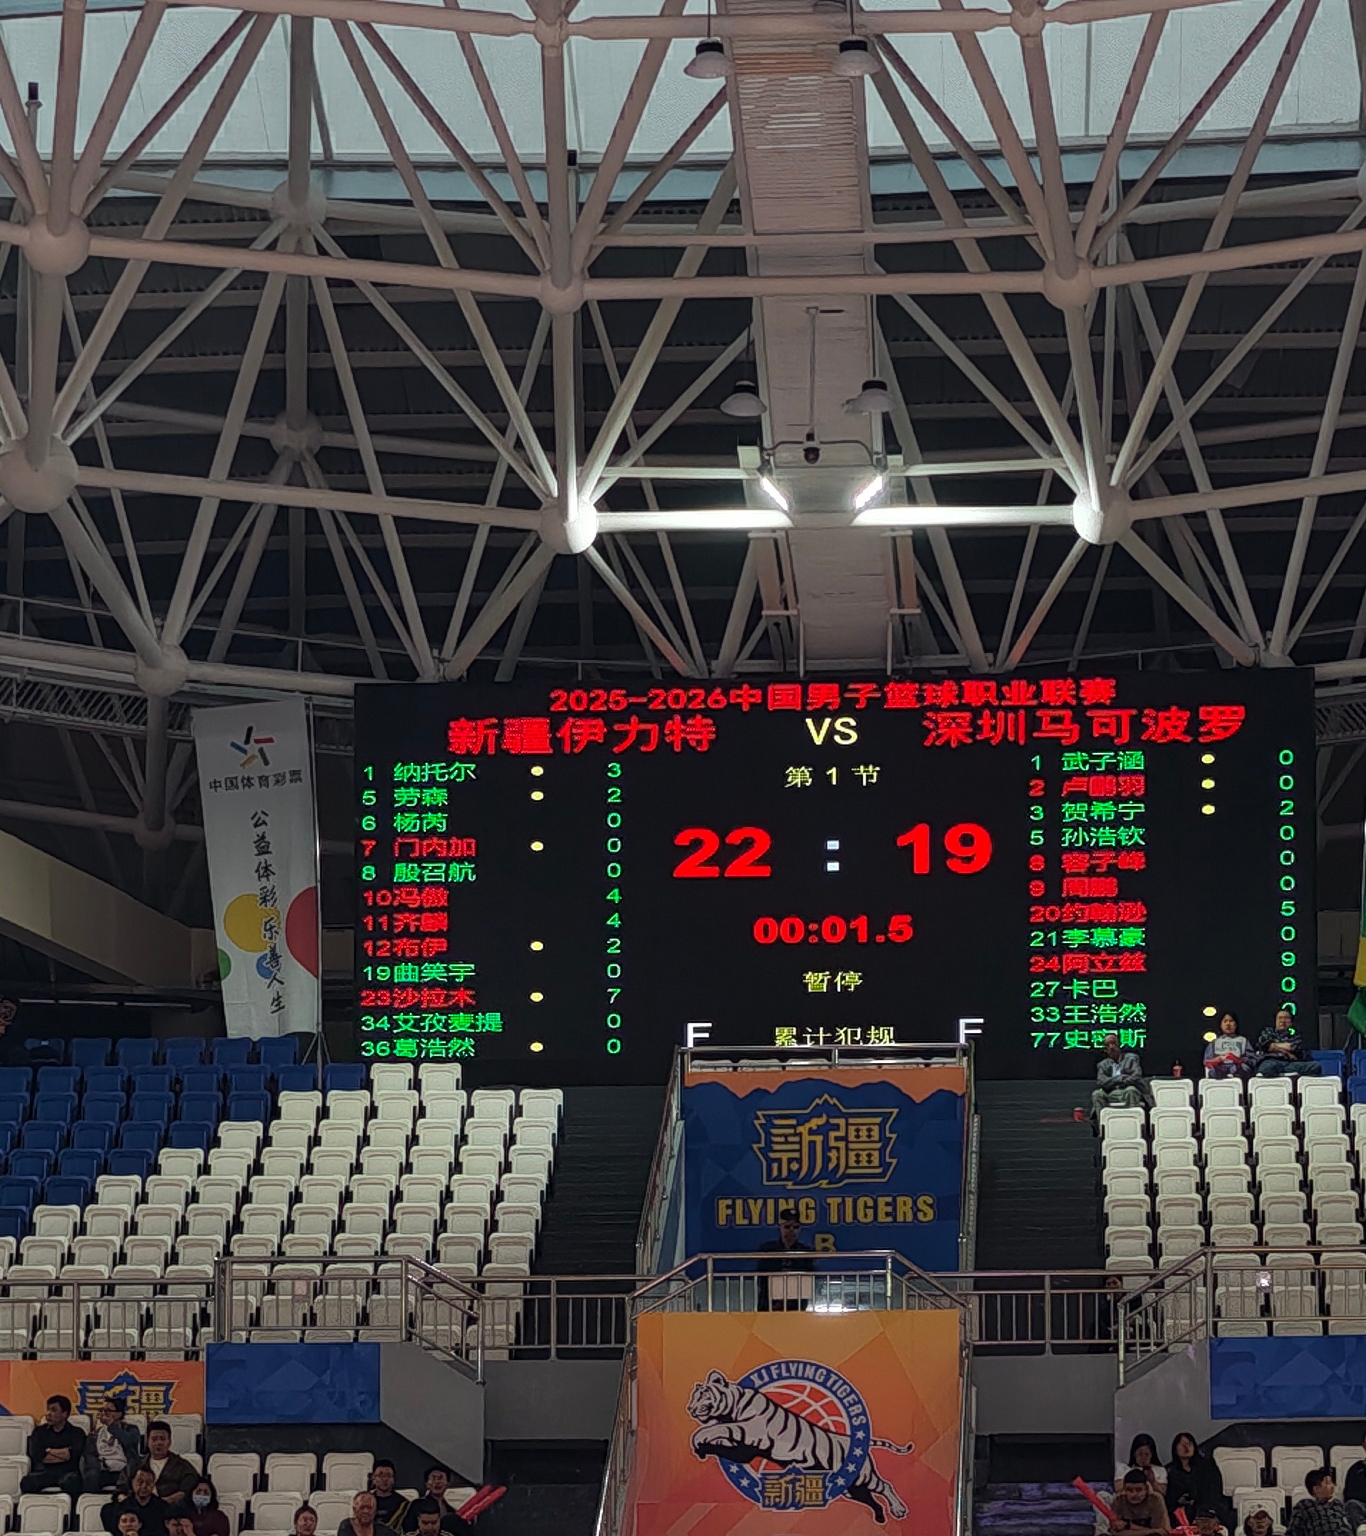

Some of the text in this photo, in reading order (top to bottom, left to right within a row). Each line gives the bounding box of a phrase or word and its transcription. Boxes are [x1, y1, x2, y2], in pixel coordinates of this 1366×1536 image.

[550, 677, 1118, 713] 2025-2026中国男子篮球职业联赛
[448, 704, 1245, 755] 新疆伊力特 VS 深圳马可波罗
[1031, 750, 1293, 771] 1 武子涵 0
[209, 769, 303, 793] 中国体育彩票
[364, 761, 621, 782] 1 纳托尔 3
[1029, 779, 1045, 796] 2
[1279, 775, 1293, 790] 0
[363, 787, 621, 807] 5 劳森 2
[362, 816, 376, 830] 6
[607, 813, 621, 827] 0
[1030, 800, 1294, 822] 3 贺希宁 2
[1030, 826, 1294, 846] 5 孙浩钦 0
[362, 837, 621, 858] 7 门内加 0
[673, 823, 992, 878] 22 19
[1280, 850, 1294, 865] 0
[362, 866, 376, 880] 8
[607, 863, 621, 877] 0
[1280, 876, 1295, 890] 0
[364, 890, 391, 906] 10
[606, 888, 622, 903] 4
[364, 915, 388, 931] 11
[606, 913, 621, 928] 4
[1030, 906, 1062, 922] 20
[1280, 901, 1295, 916] 5
[753, 915, 913, 944] 00:01.5
[1030, 926, 1295, 948] 21 李慕豪 0
[364, 937, 620, 957] 12 布伊 2
[364, 966, 390, 980] 19
[607, 964, 621, 978] 0
[1030, 955, 1061, 972] 24
[1281, 952, 1295, 966] 9
[803, 971, 863, 992] 暂停
[1030, 977, 1296, 999] 27 卡巴 0
[361, 990, 391, 1006] 23
[607, 988, 621, 1003] 7
[361, 1016, 390, 1030] 34
[607, 1014, 621, 1028] 0
[1031, 1003, 1146, 1023] 33 王浩然
[687, 1018, 983, 1047] F 累计犯规 F
[1031, 1033, 1061, 1048] 77
[361, 1037, 620, 1058] 36 葛浩然 0
[767, 1113, 884, 1180] 新疆
[827, 1194, 936, 1224] TIGERS
[770, 1362, 827, 1385] FLYING
[825, 1371, 867, 1427] TIGERS
[762, 1475, 828, 1507] 新疆
